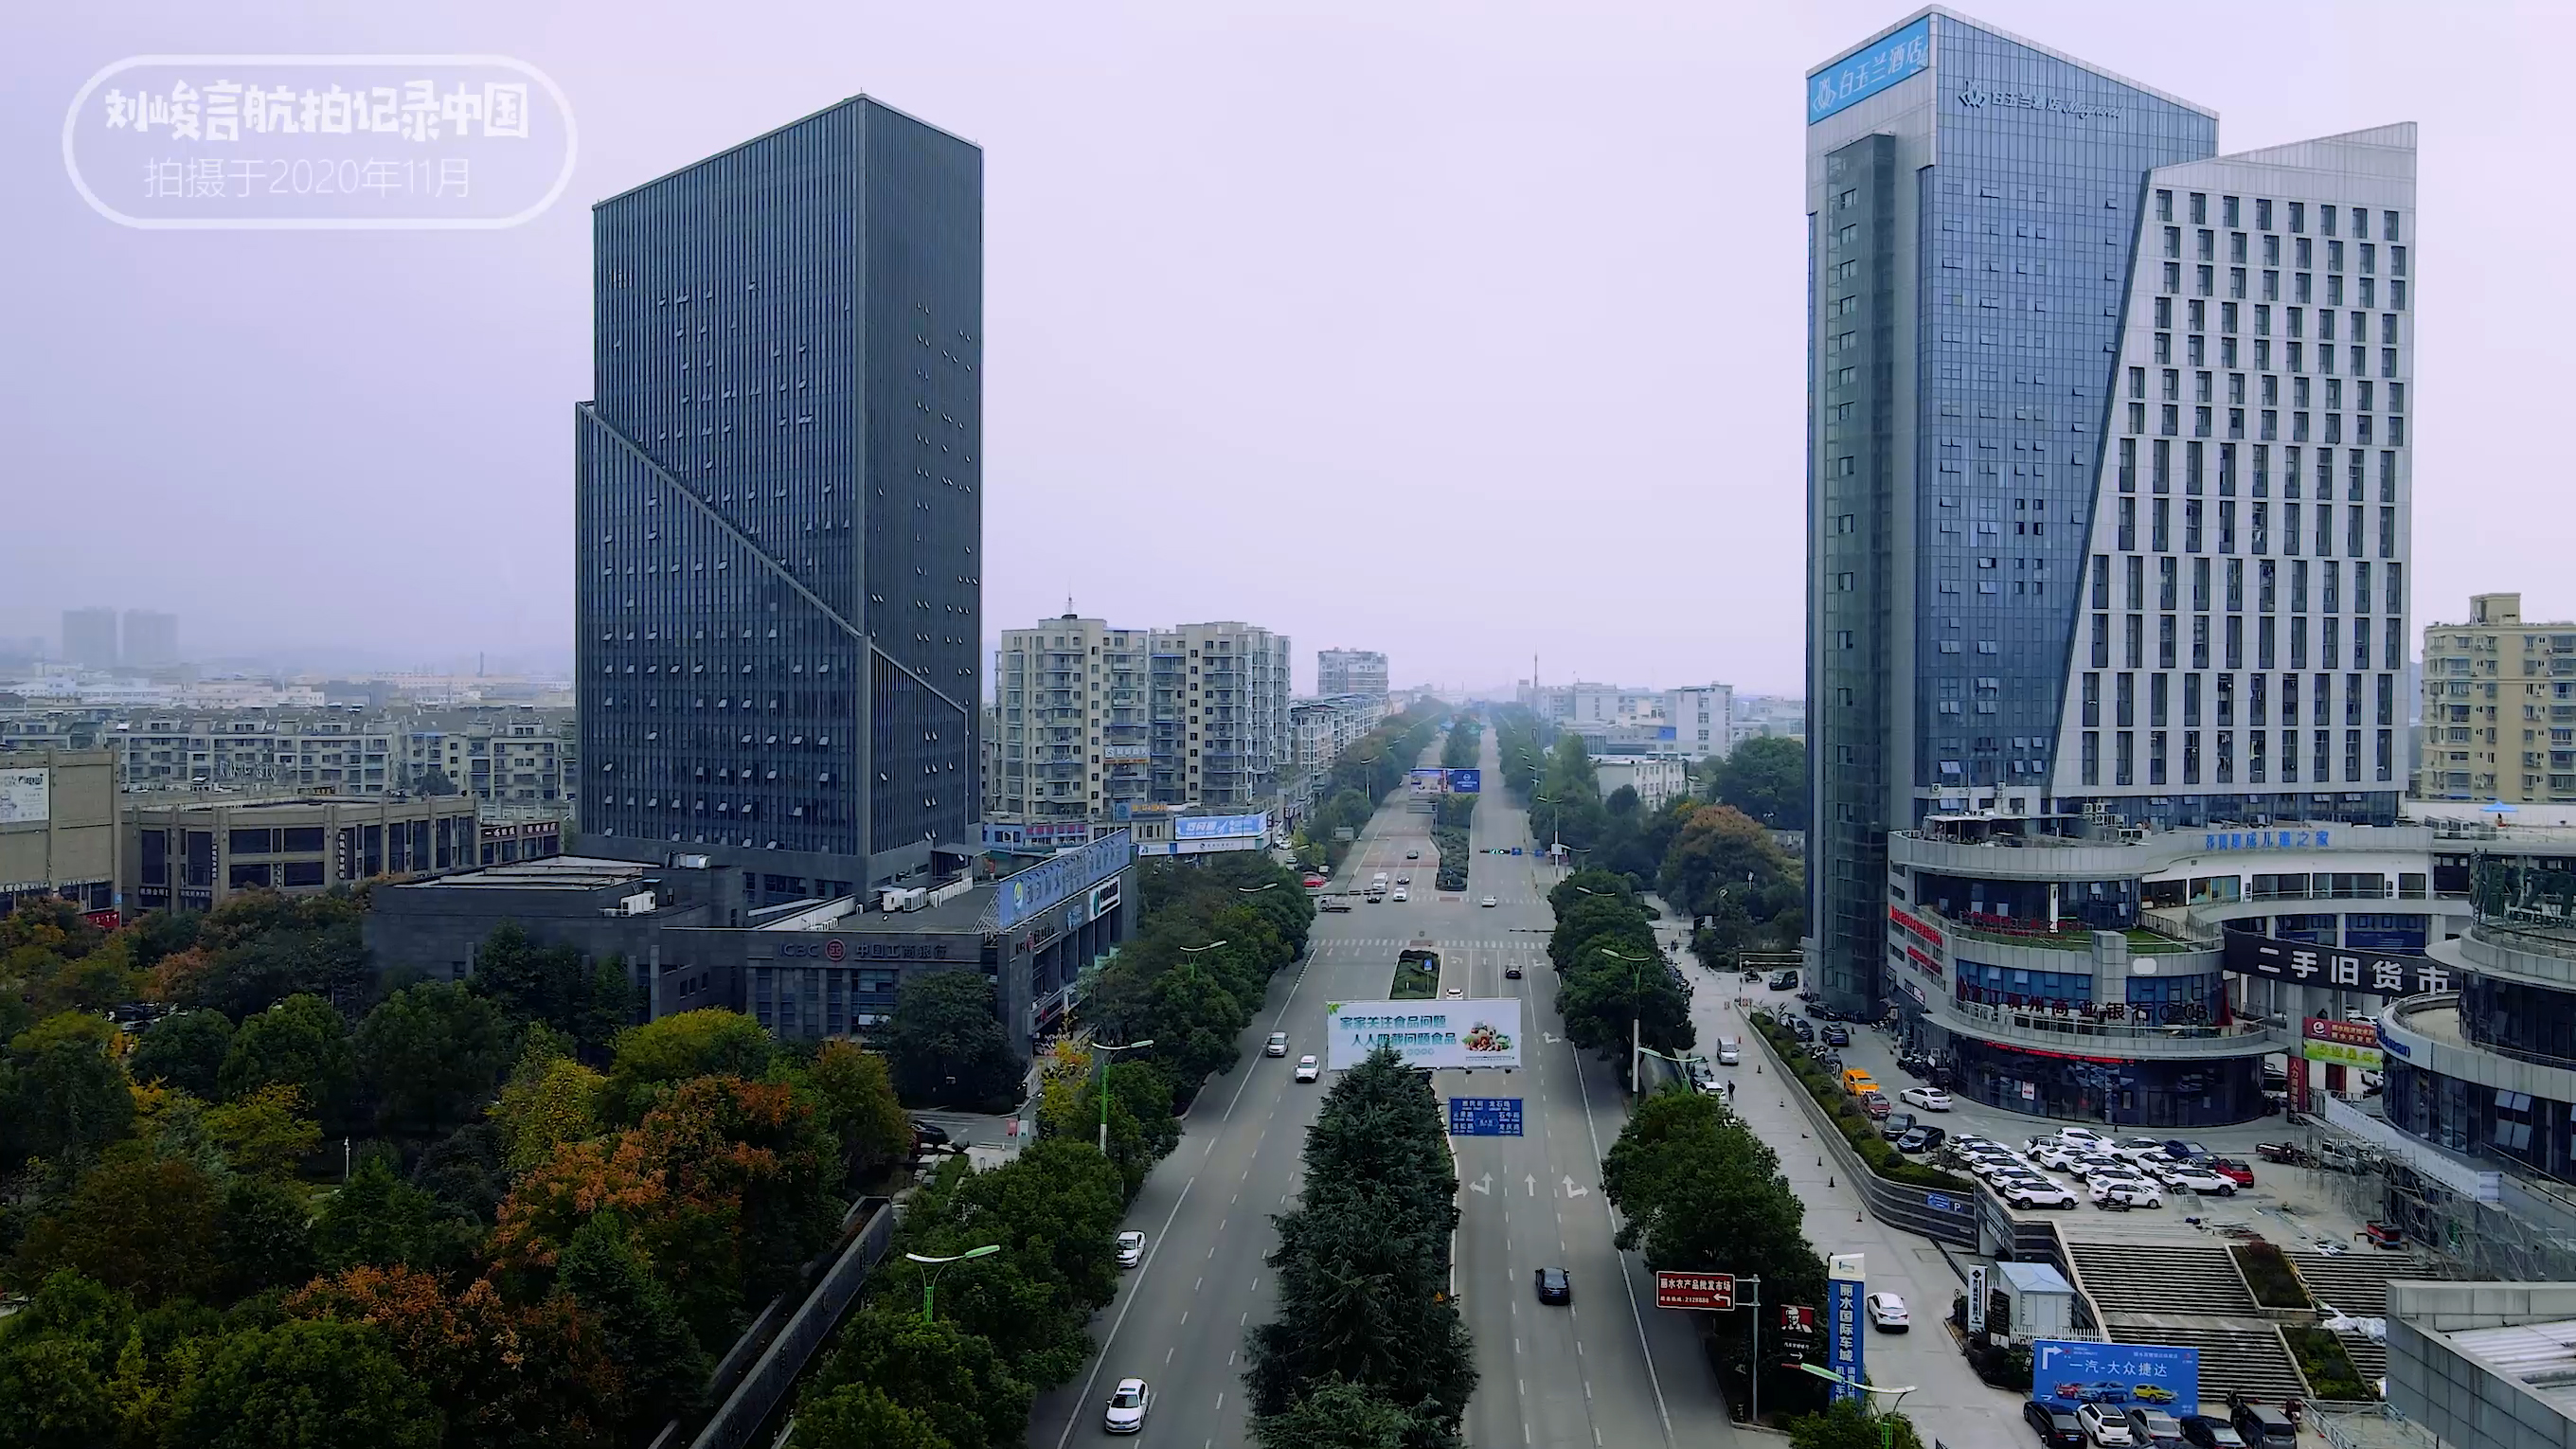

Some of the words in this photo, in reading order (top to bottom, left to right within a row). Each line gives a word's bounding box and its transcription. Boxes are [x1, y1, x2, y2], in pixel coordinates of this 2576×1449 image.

[1839, 34, 1925, 99] 白玉兰酒店
[1991, 90, 2062, 112] 白玉兰酒店
[778, 942, 820, 957] ICBC
[856, 942, 947, 960] 中国工商银行
[1340, 1015, 1447, 1030] 家家关注食品问题
[1351, 1031, 1457, 1047] 人人阻截问题食品
[1660, 1278, 1731, 1292] 丽水农产品批发市场
[1838, 1283, 1854, 1363] 丽水国际车城
[2069, 1358, 2169, 1378] 一汽-大众捷达
